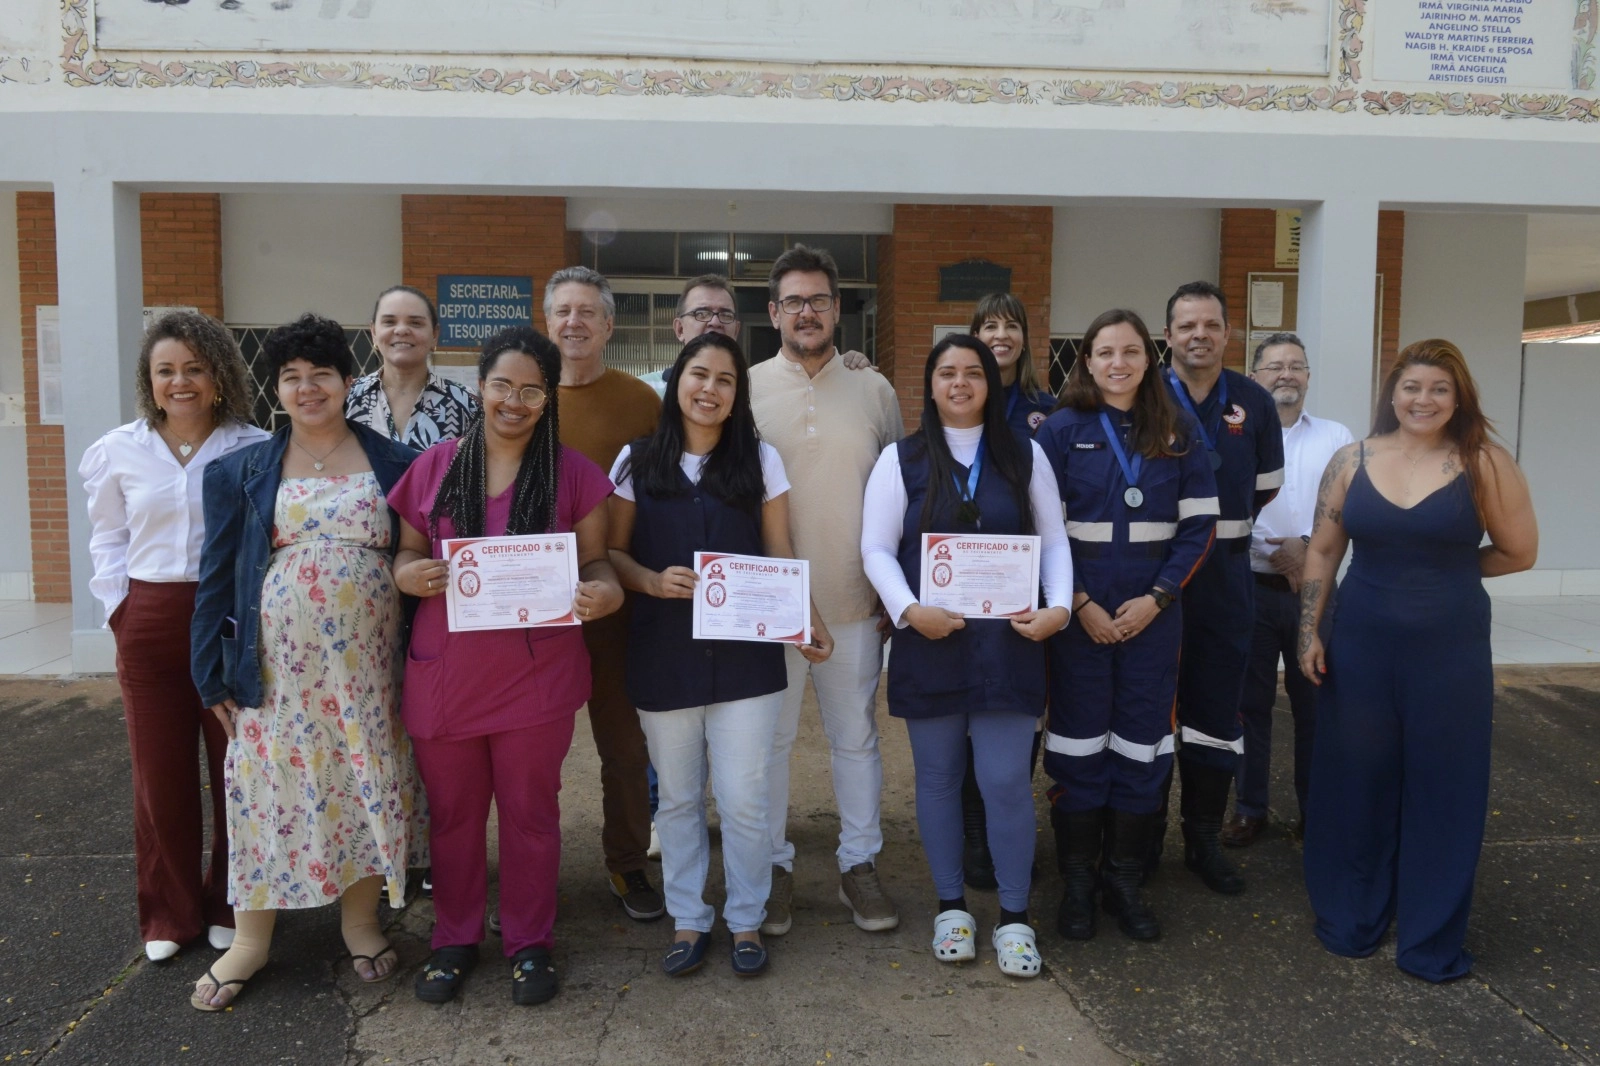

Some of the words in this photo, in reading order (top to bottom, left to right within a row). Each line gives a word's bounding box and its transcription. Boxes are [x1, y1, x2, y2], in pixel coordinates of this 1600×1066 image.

[1418, 1, 1443, 10] IRMÃ
[1447, 3, 1489, 12] VIRGINIA
[1492, 6, 1524, 14] MARIA
[1420, 12, 1466, 21] JAIRINHO
[1484, 16, 1521, 24] MATTOS
[1429, 23, 1478, 32] ANGELINO
[1482, 25, 1511, 33] STELLA
[1405, 32, 1444, 40] WALDYR
[1447, 34, 1489, 42] MARTINS
[1492, 36, 1534, 45] FERREIRA
[1452, 45, 1486, 53] KRAIDE
[1498, 47, 1533, 55] ESPOSA
[1430, 52, 1454, 61] IRMÃ
[1458, 54, 1507, 63] VICENTINA
[1432, 62, 1455, 71] IRMÃ
[1459, 65, 1504, 74] ANGELICA
[1428, 74, 1474, 82] ARISTIDES
[1477, 76, 1507, 84] GIUSTI
[450, 284, 519, 299] SECRETARIA
[440, 304, 529, 319] DEPTO.PESSOAL
[448, 324, 517, 338] TESOURAR
[482, 544, 540, 554] CERTIFICADO
[956, 542, 1008, 550] CERTIFICADO
[730, 562, 779, 573] CERTIFICADO
